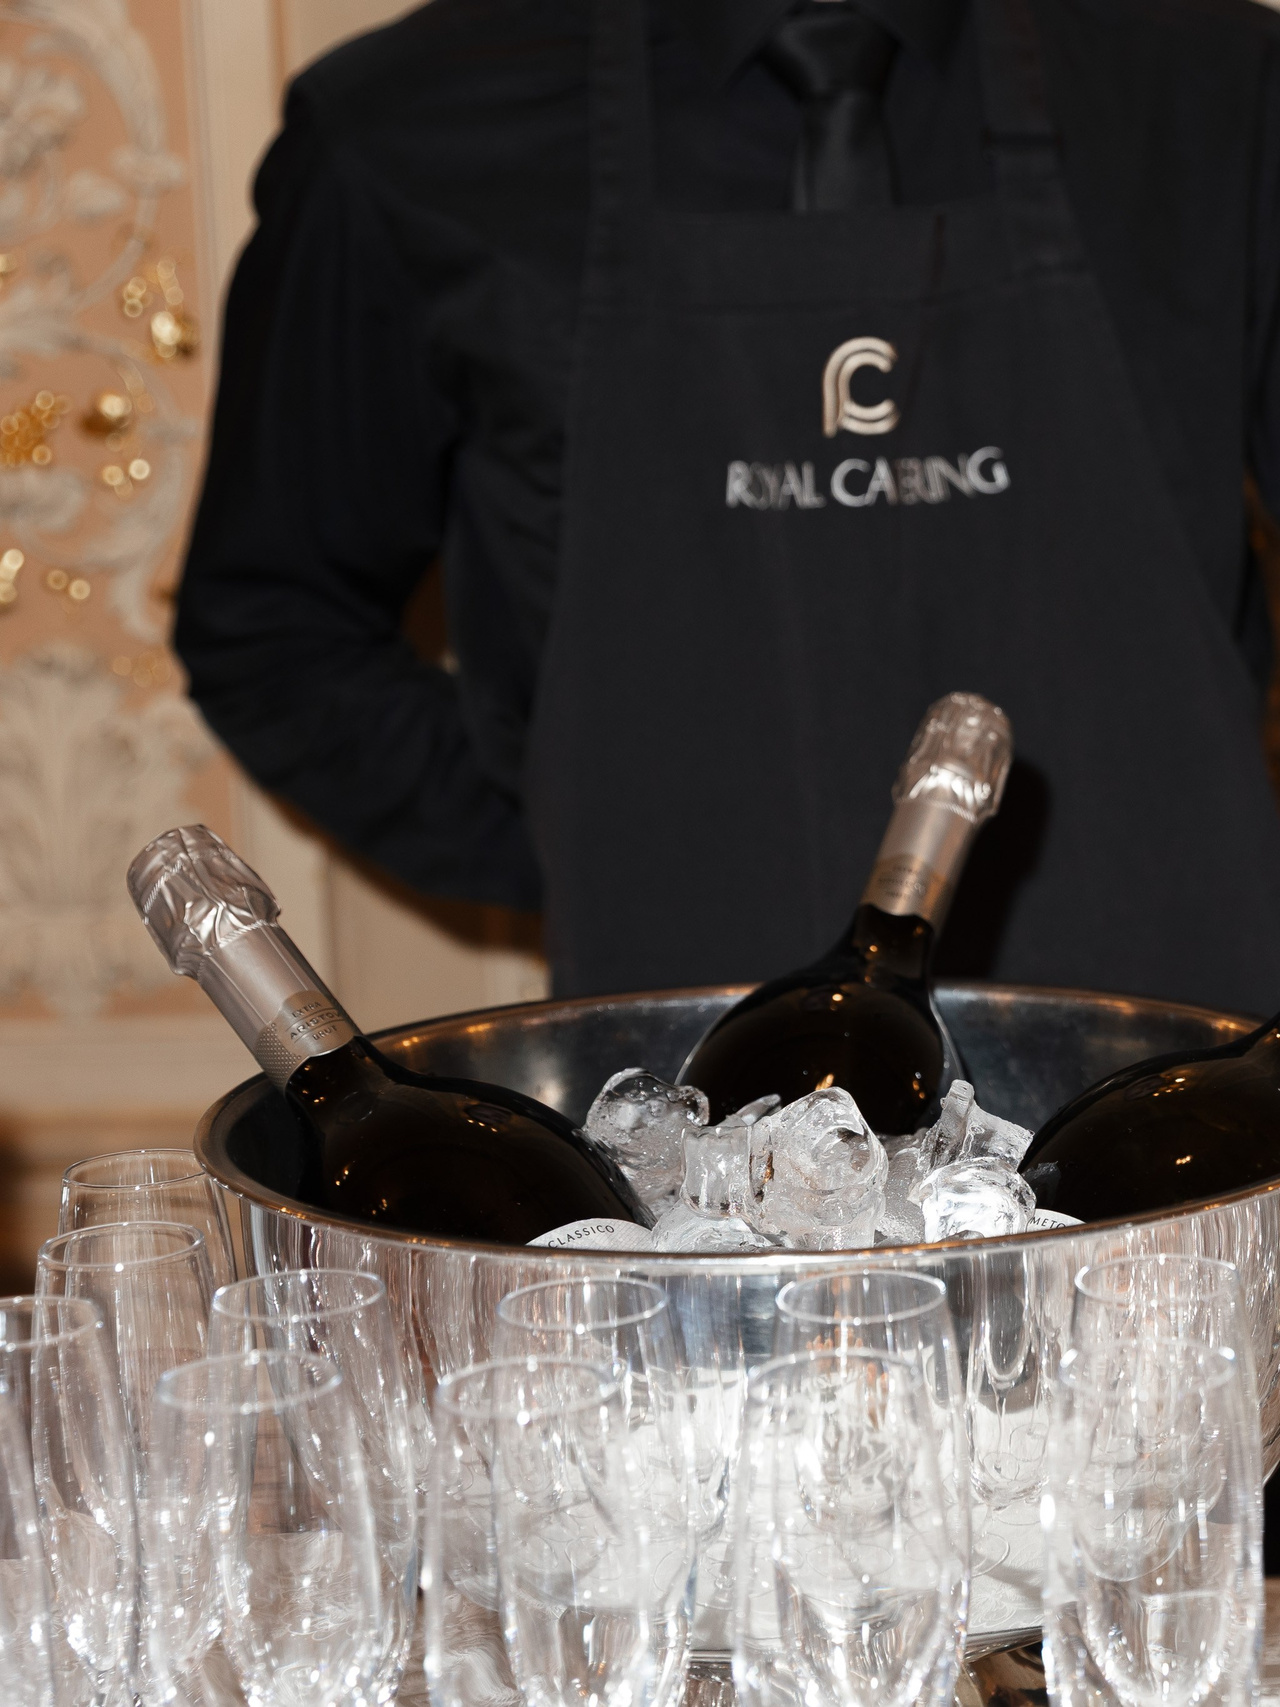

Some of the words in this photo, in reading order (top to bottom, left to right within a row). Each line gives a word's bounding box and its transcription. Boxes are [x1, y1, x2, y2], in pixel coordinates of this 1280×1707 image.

[292, 1002, 321, 1018] EXTRA
[312, 1025, 338, 1041] BRUT
[547, 1224, 615, 1249] CLASSICO
